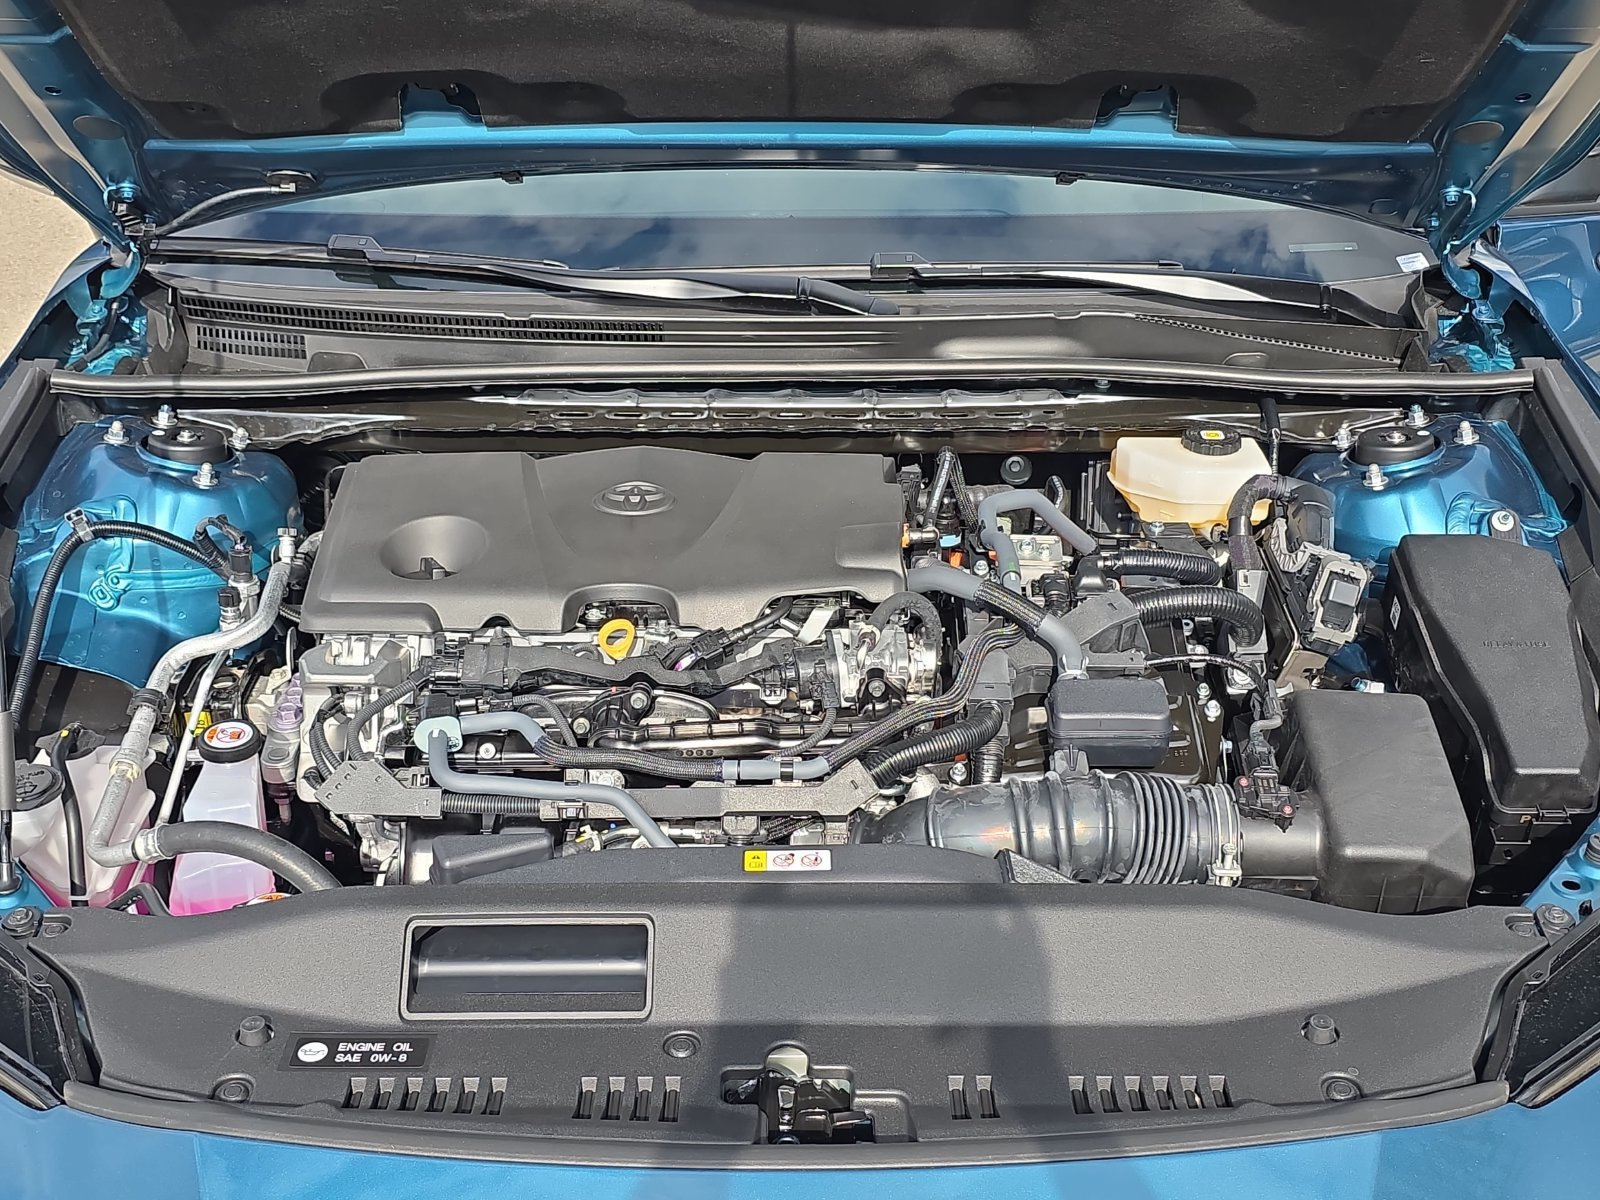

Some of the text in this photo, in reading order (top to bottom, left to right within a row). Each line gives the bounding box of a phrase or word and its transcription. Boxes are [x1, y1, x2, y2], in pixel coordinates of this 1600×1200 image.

[337, 1042, 414, 1052] ENGINE OIL
[334, 1053, 408, 1063] SAE 0W-8
